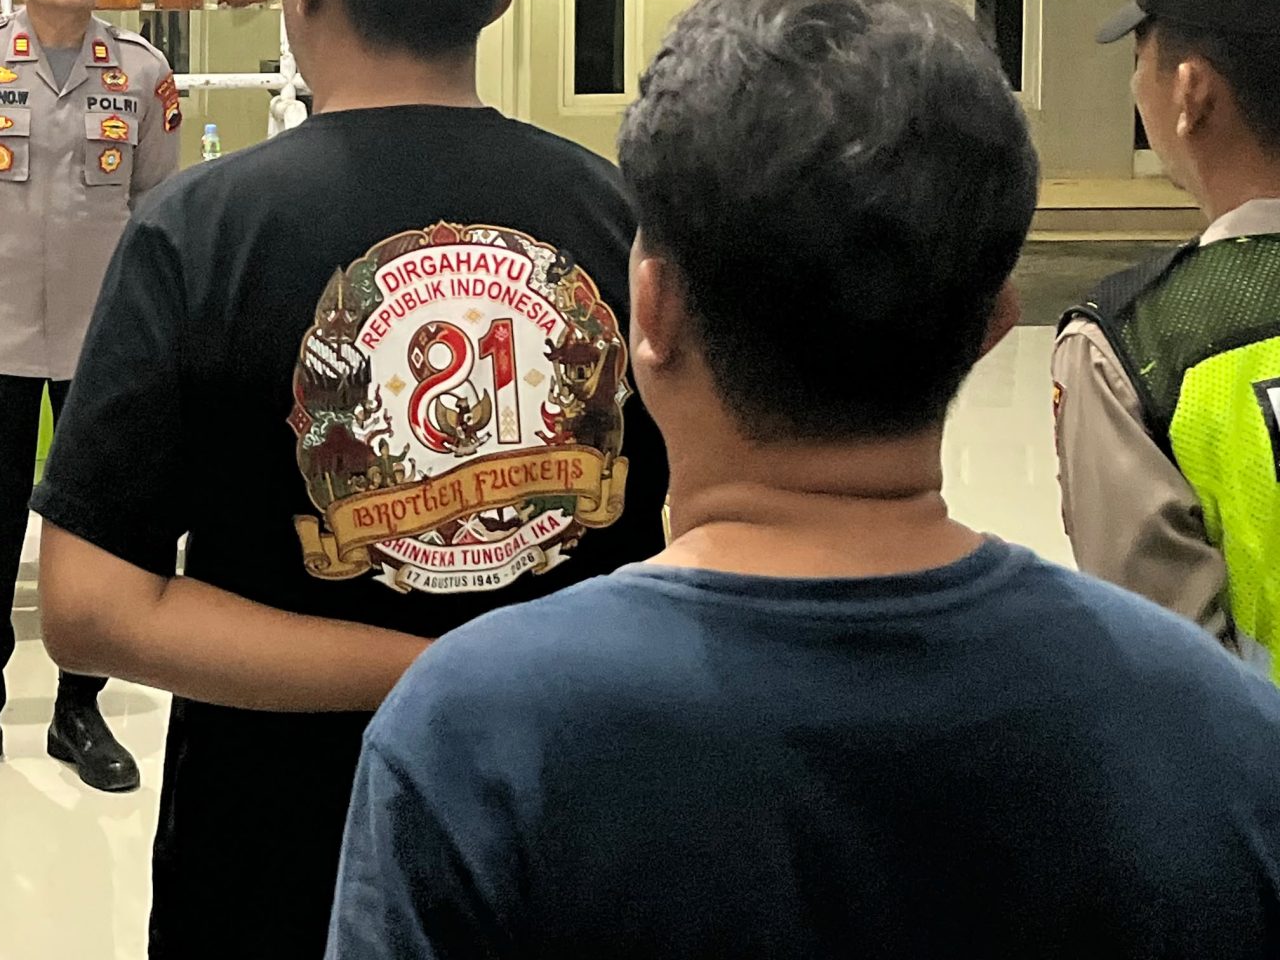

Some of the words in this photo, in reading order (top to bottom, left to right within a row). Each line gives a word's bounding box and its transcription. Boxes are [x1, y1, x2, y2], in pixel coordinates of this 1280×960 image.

[87, 96, 138, 113] POLRI
[382, 252, 526, 293] DIRGAHAYU
[361, 280, 446, 350] REPUBLIK
[450, 278, 557, 336] INDONESIA
[407, 318, 522, 454] 81
[470, 457, 584, 505] FUCKERS
[460, 533, 530, 566] TUNGGAL
[530, 515, 561, 539] IKA
[406, 570, 420, 583] 17
[423, 575, 468, 589] AGUSTUS
[472, 573, 501, 587] 1945
